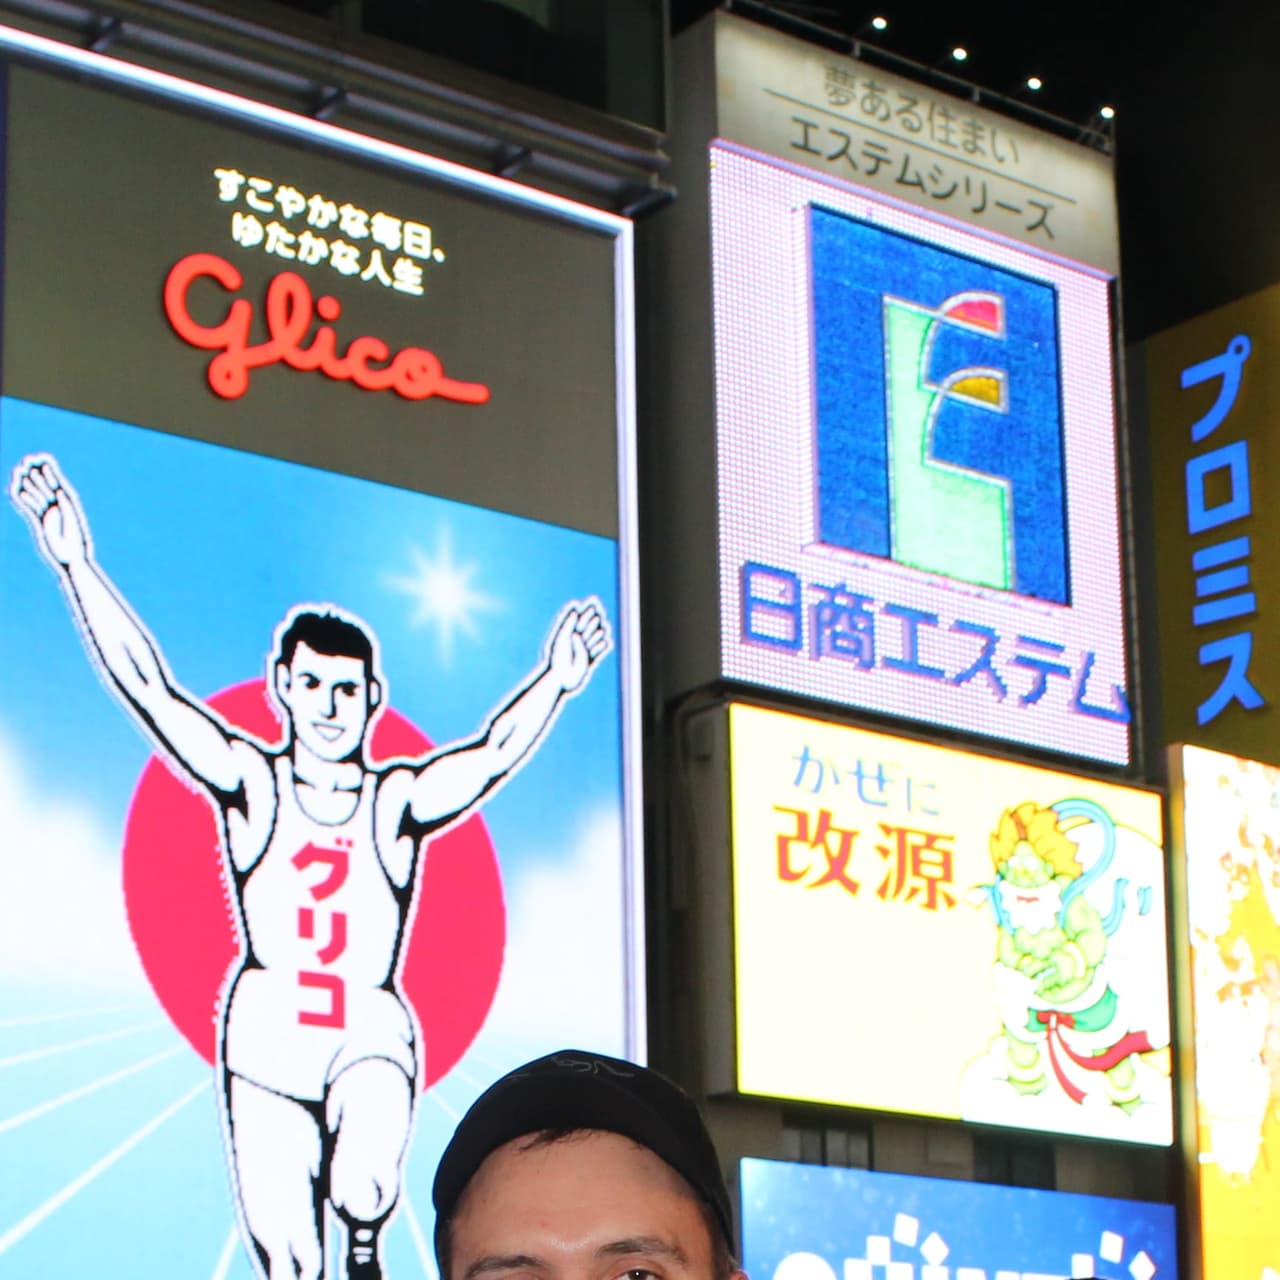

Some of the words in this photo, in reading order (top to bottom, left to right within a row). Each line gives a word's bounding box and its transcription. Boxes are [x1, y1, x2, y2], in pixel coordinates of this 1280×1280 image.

[790, 115, 1056, 241] エステムシリーズ
[823, 64, 1021, 166] 夢ある住まい
[231, 213, 425, 296] ゆたかな人生
[163, 252, 492, 404] Glico
[1180, 334, 1266, 726] プロミス
[740, 559, 1132, 724] 日商エステム
[772, 804, 958, 911] 改源
[289, 835, 356, 1030] グリコ
